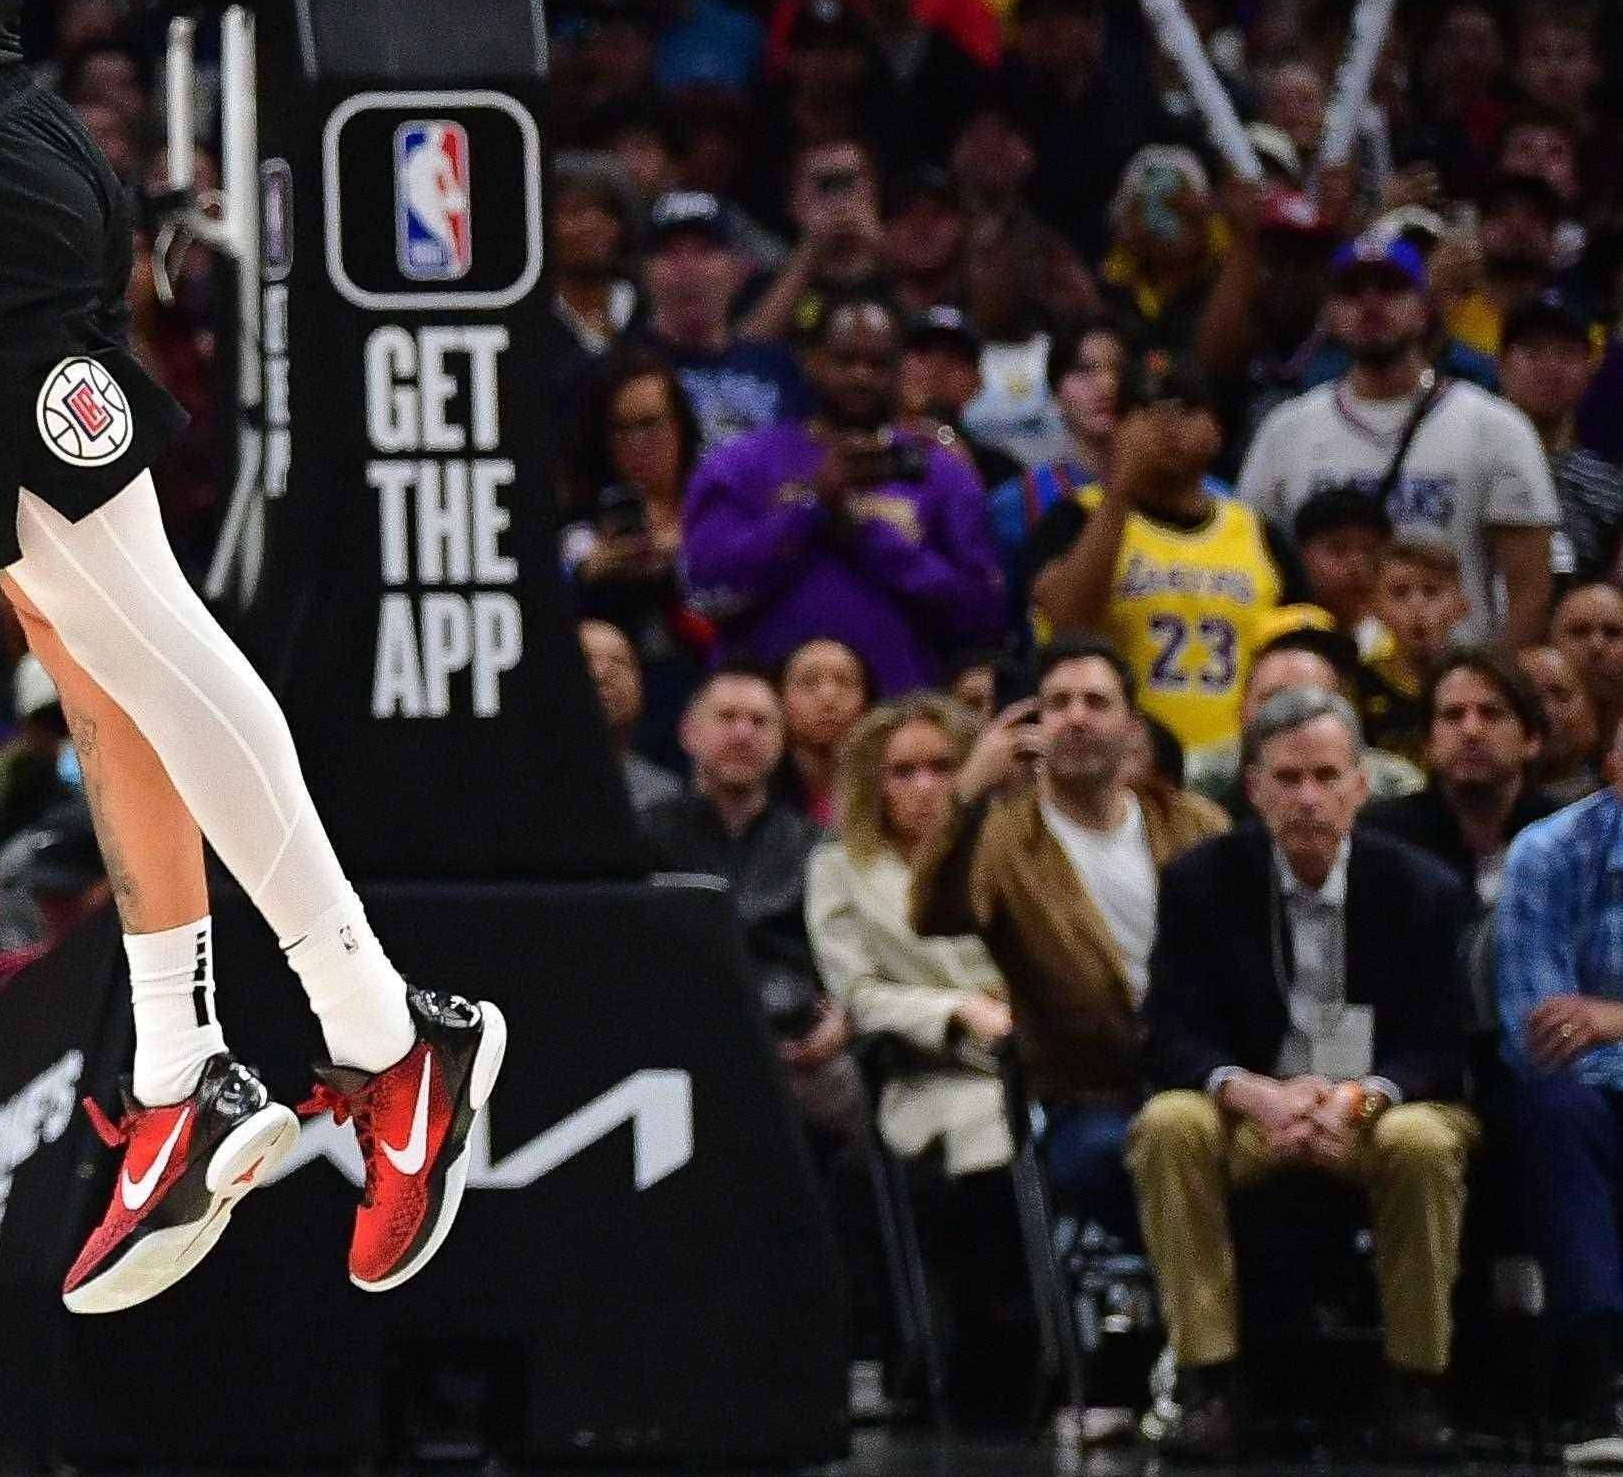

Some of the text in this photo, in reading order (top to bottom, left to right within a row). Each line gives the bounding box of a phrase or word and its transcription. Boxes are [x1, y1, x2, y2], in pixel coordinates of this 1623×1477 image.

[362, 324, 511, 453] GET
[364, 456, 520, 586] THE
[370, 589, 524, 719] APP
[1146, 612, 1239, 694] 23
